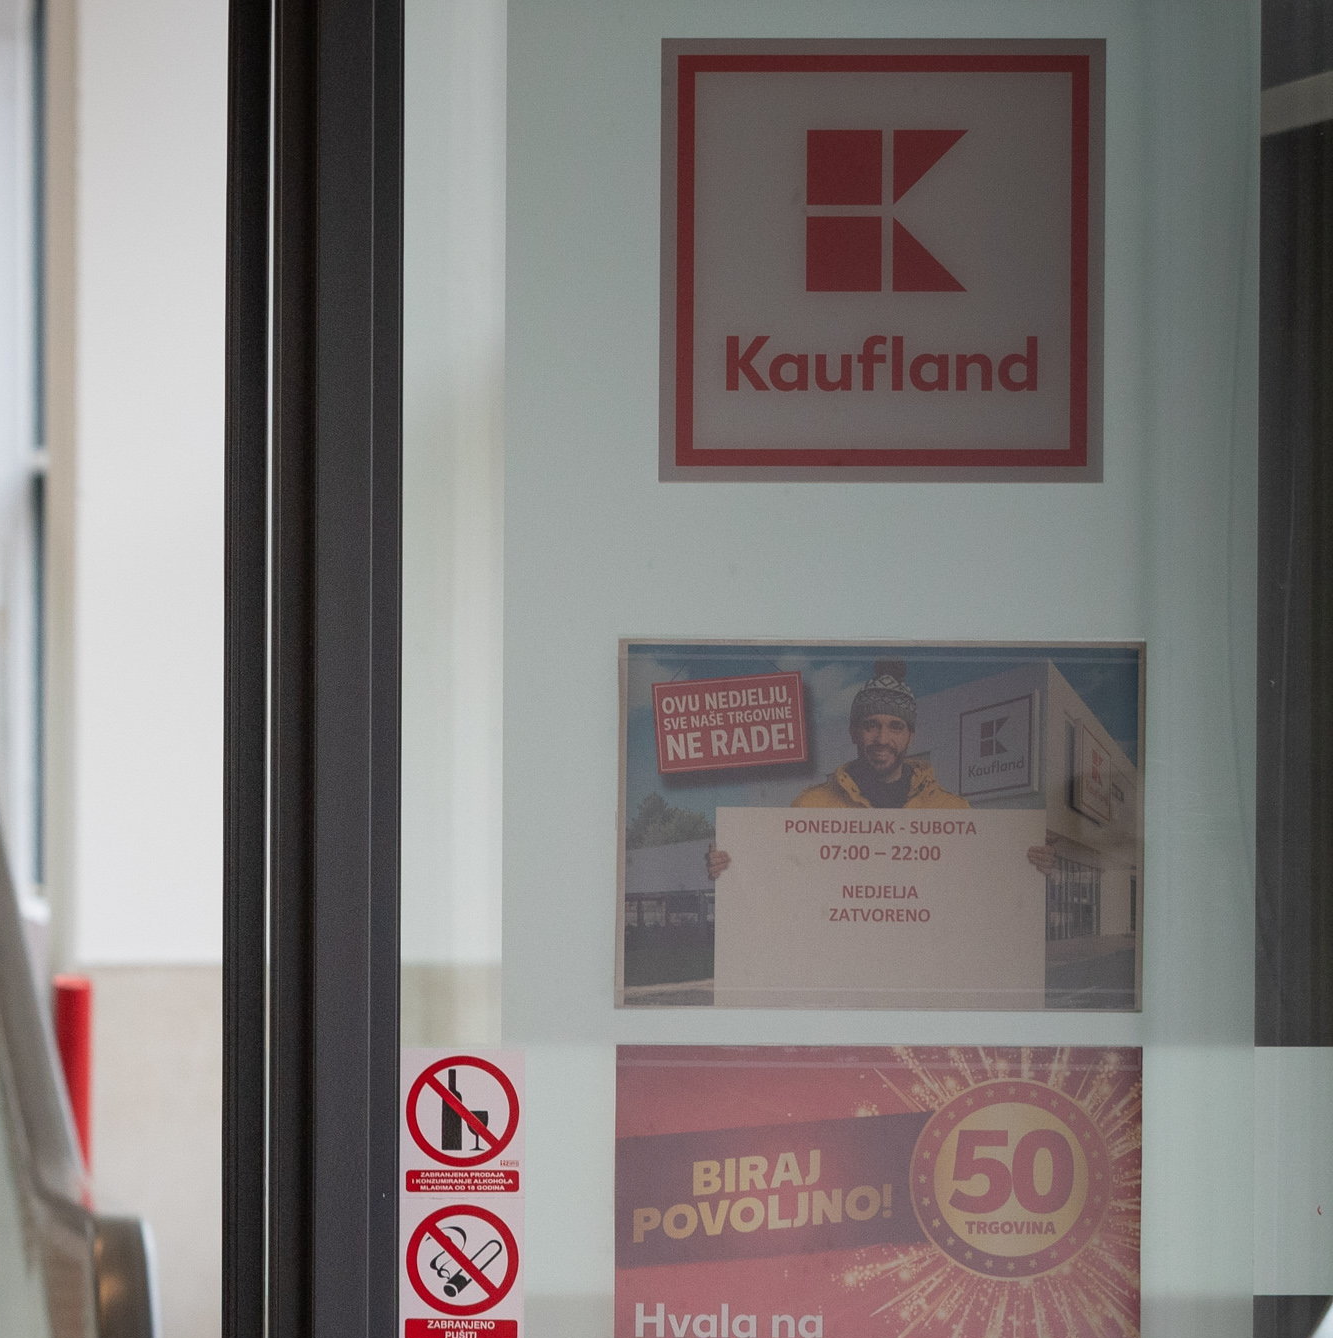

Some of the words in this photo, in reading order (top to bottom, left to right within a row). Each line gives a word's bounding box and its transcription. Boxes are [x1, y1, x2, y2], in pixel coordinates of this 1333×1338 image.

[725, 335, 1039, 392] Kaufland
[661, 694, 700, 715] OVU
[704, 685, 792, 711] NEDJELJU,
[663, 716, 687, 731] SVE
[690, 711, 725, 728] NAŠE
[727, 706, 793, 724] TRGOVINE
[665, 731, 704, 761] NE
[710, 722, 795, 757] RADE!
[967, 755, 1026, 779] Kaufland
[784, 819, 896, 835] PONEDJELJAK
[909, 820, 977, 835] SUBOTA
[819, 845, 870, 861] 07:00
[890, 846, 941, 861] 22:00
[841, 885, 919, 899] NEDJELJA
[828, 908, 931, 923] ZATVORENO
[692, 1149, 822, 1197] BIRAJ
[947, 1128, 1075, 1216] 50
[632, 1183, 894, 1244] POVOLJNO!
[965, 1220, 1057, 1236] TRGOVINA
[427, 1320, 495, 1330] ZABRANJENO
